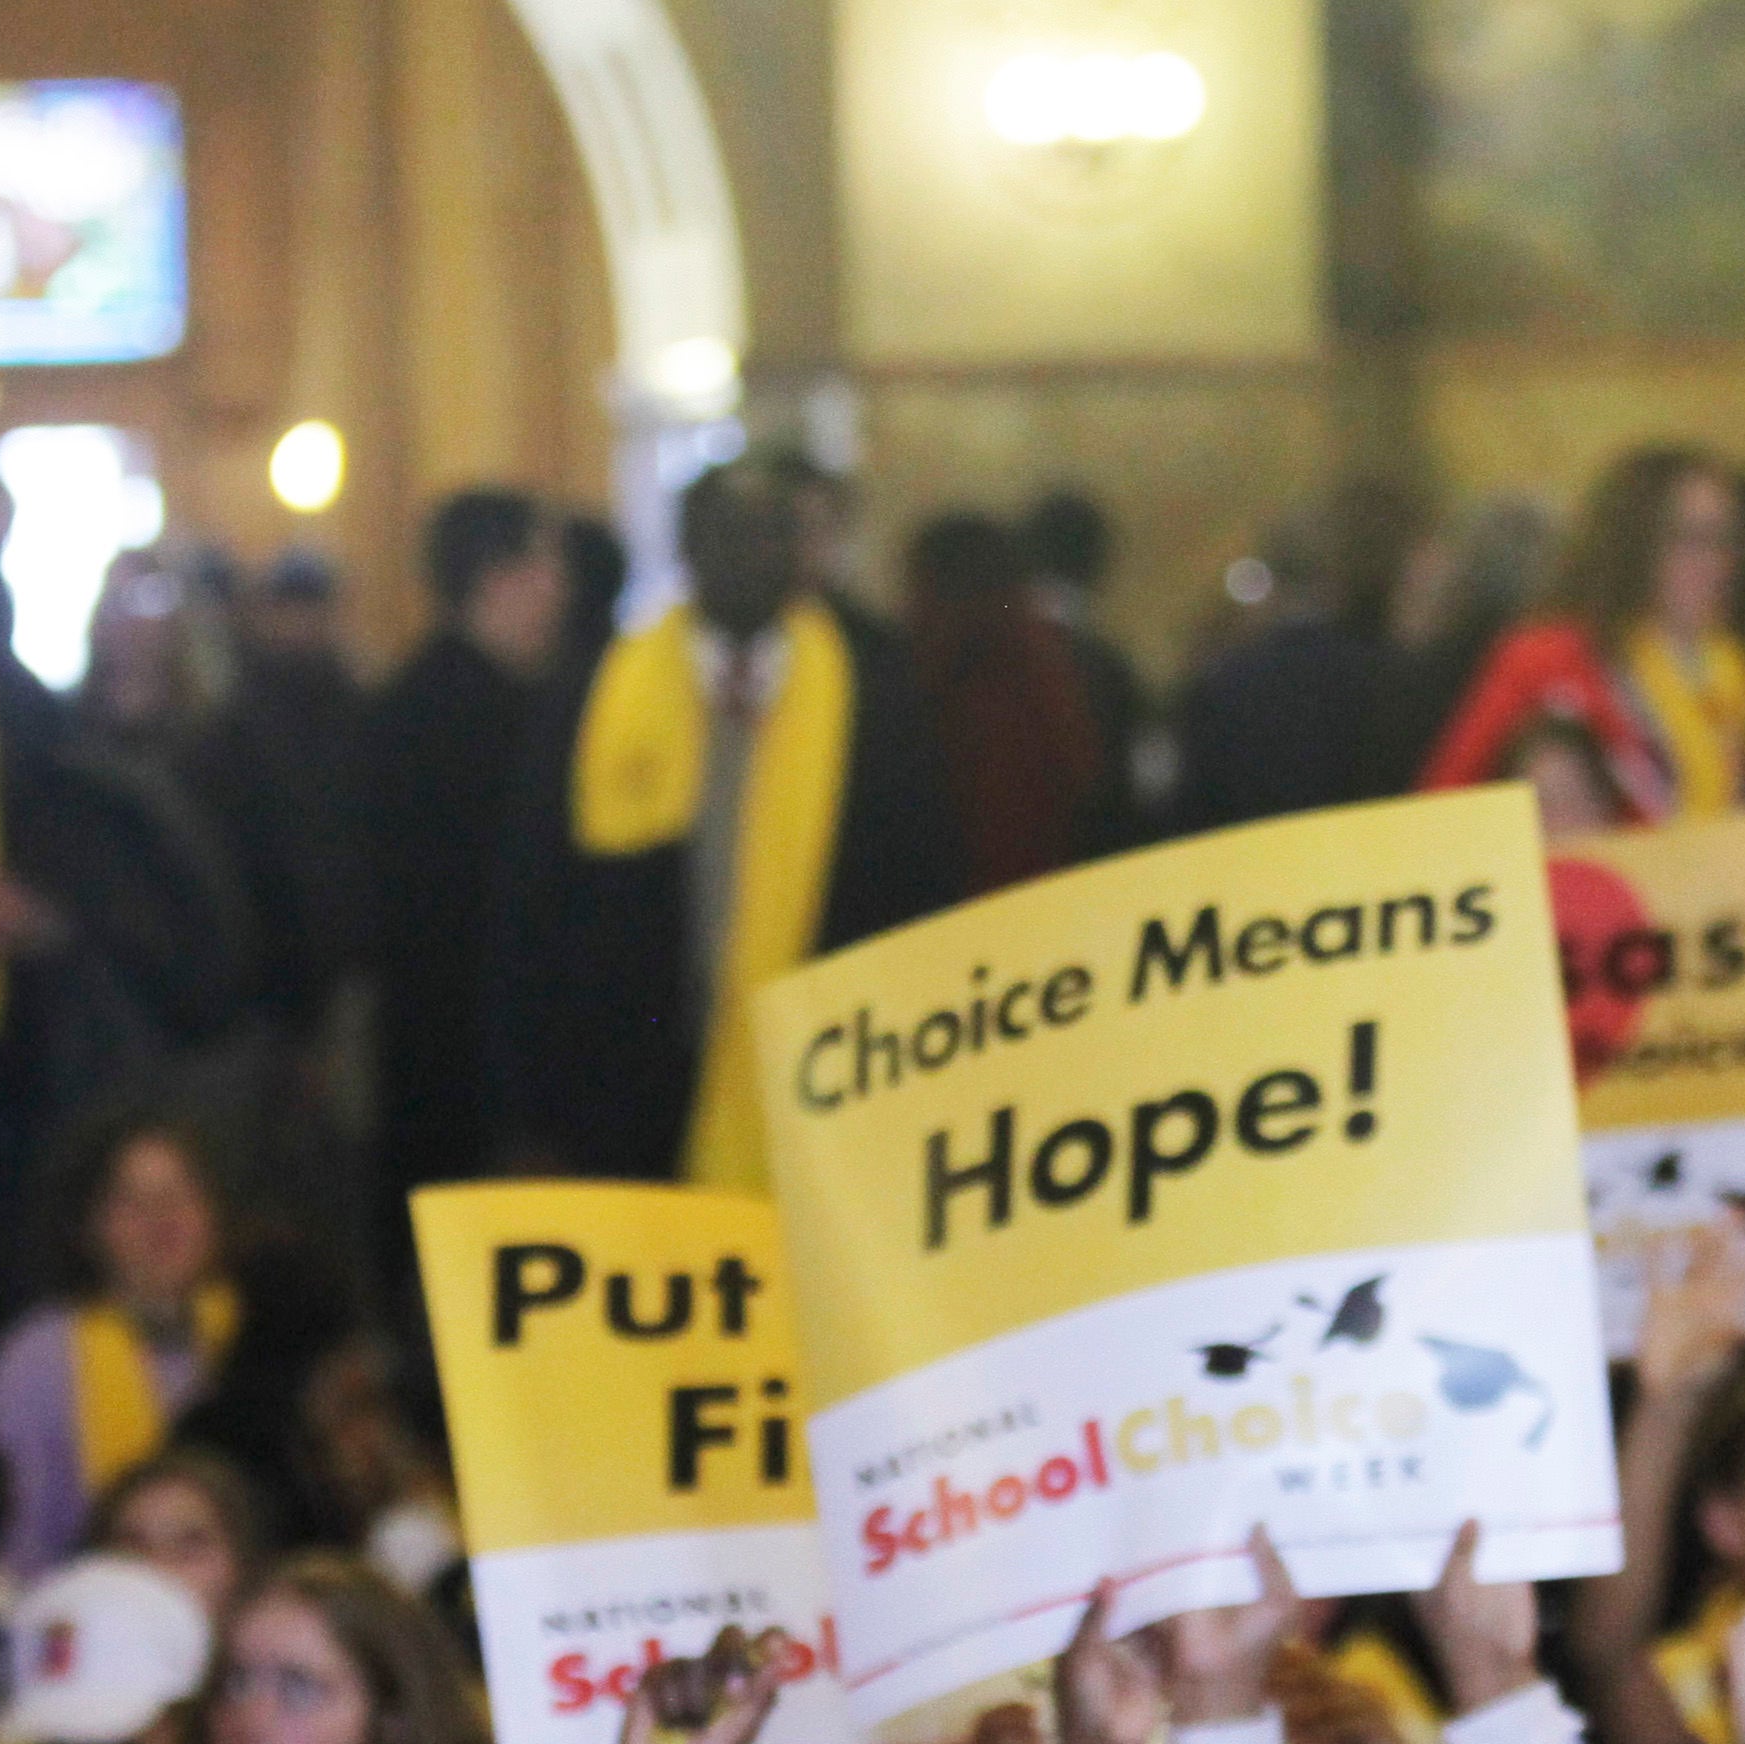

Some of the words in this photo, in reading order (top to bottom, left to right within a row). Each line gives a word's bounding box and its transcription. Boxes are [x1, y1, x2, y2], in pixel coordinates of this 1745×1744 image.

[798, 967, 1095, 1114] Choice
[1128, 884, 1497, 1007] Means
[920, 1021, 1380, 1250] Hope!
[492, 1241, 762, 1348] Put
